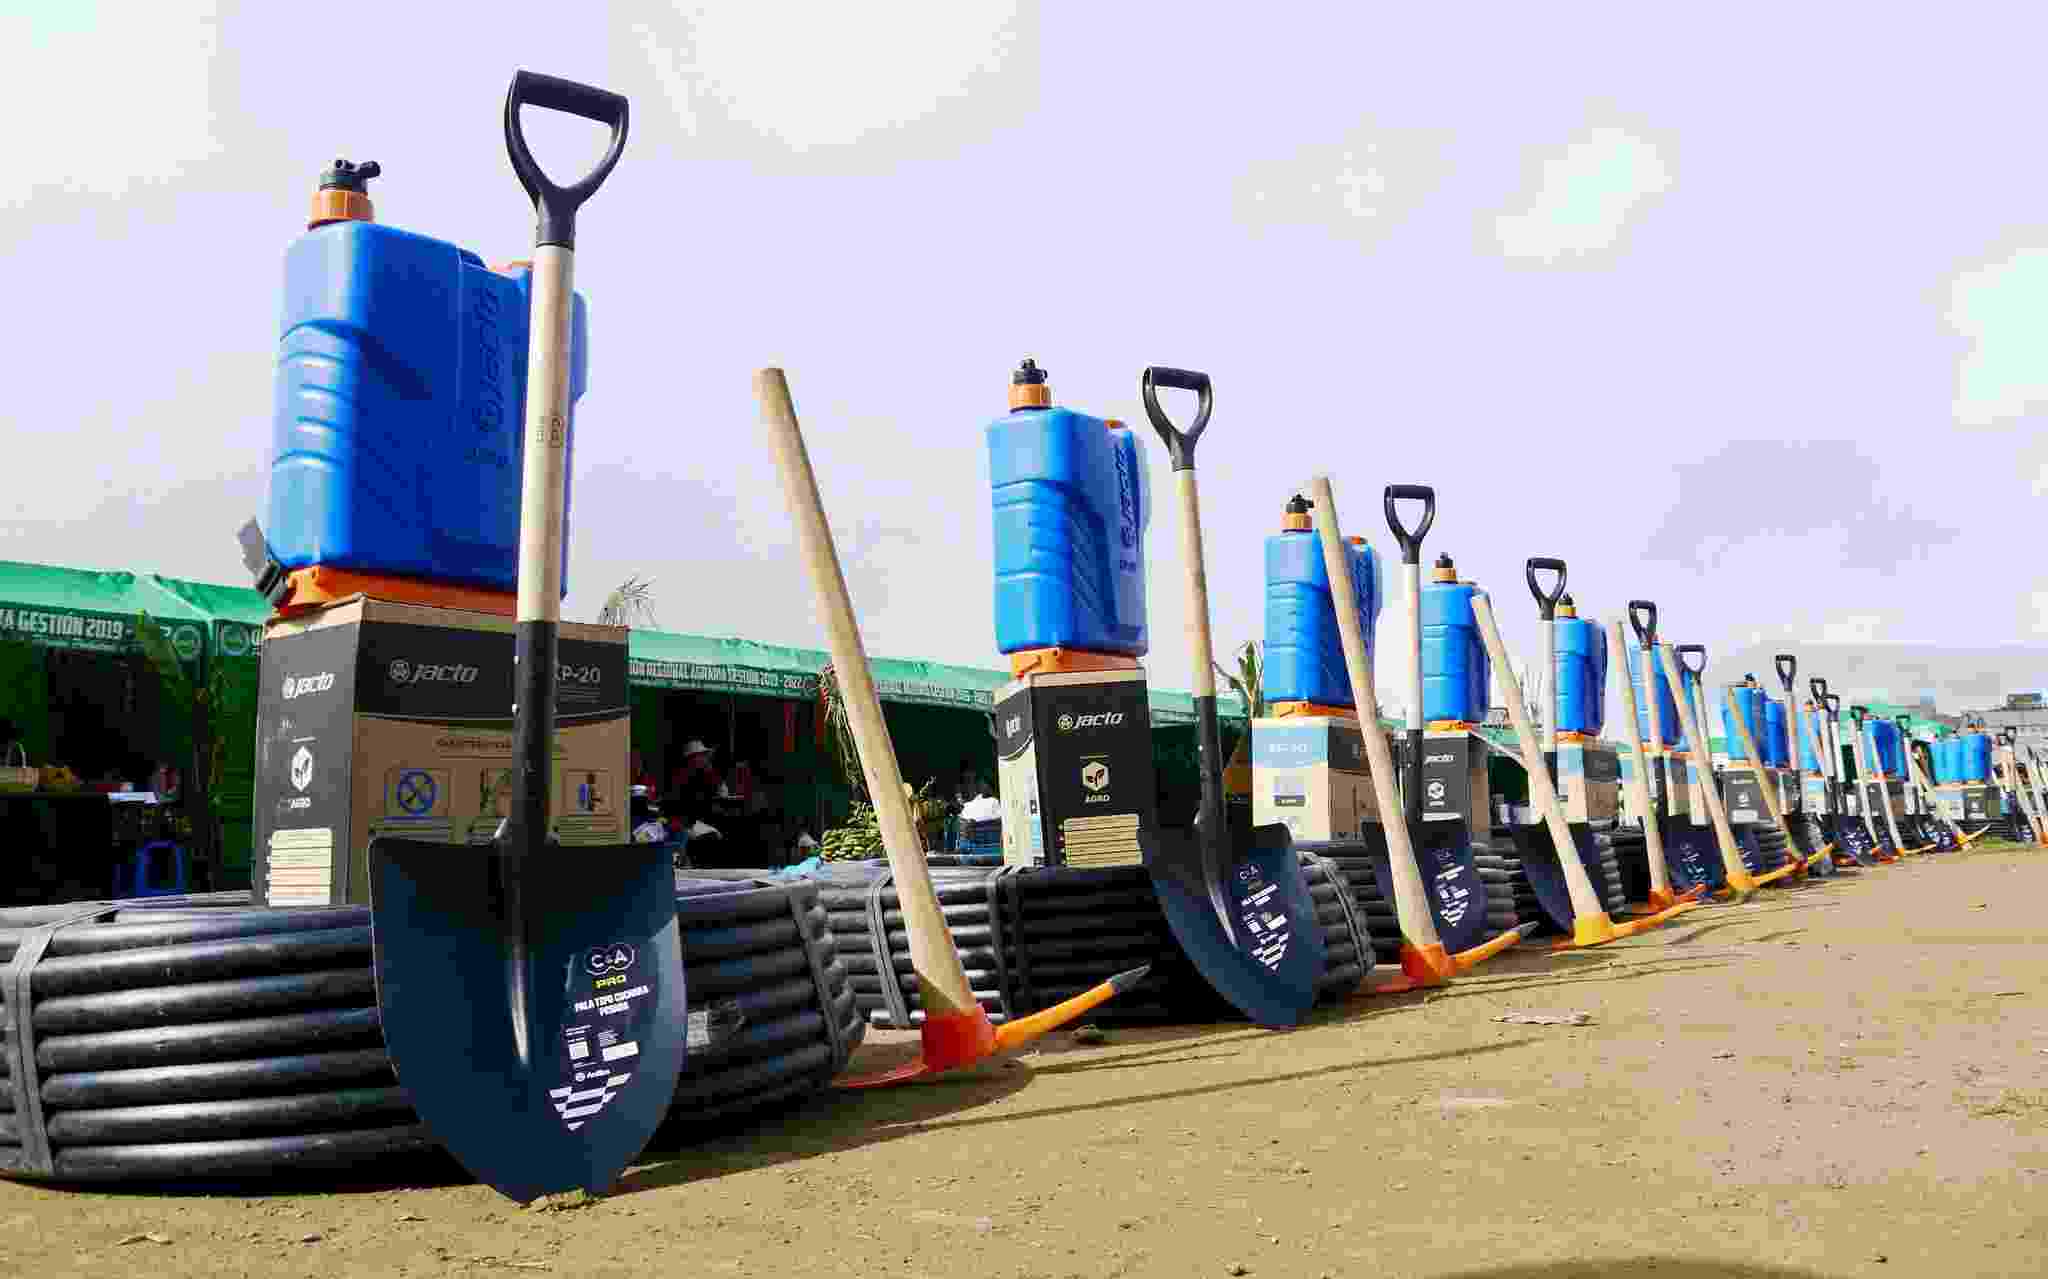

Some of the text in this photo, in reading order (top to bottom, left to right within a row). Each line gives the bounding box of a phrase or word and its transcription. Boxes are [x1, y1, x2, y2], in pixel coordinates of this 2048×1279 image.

[86, 618, 123, 640] 2019
[408, 663, 479, 684] jacto
[293, 672, 336, 697] jacto
[1074, 711, 1125, 729] jacto
[597, 975, 627, 989] PRO
